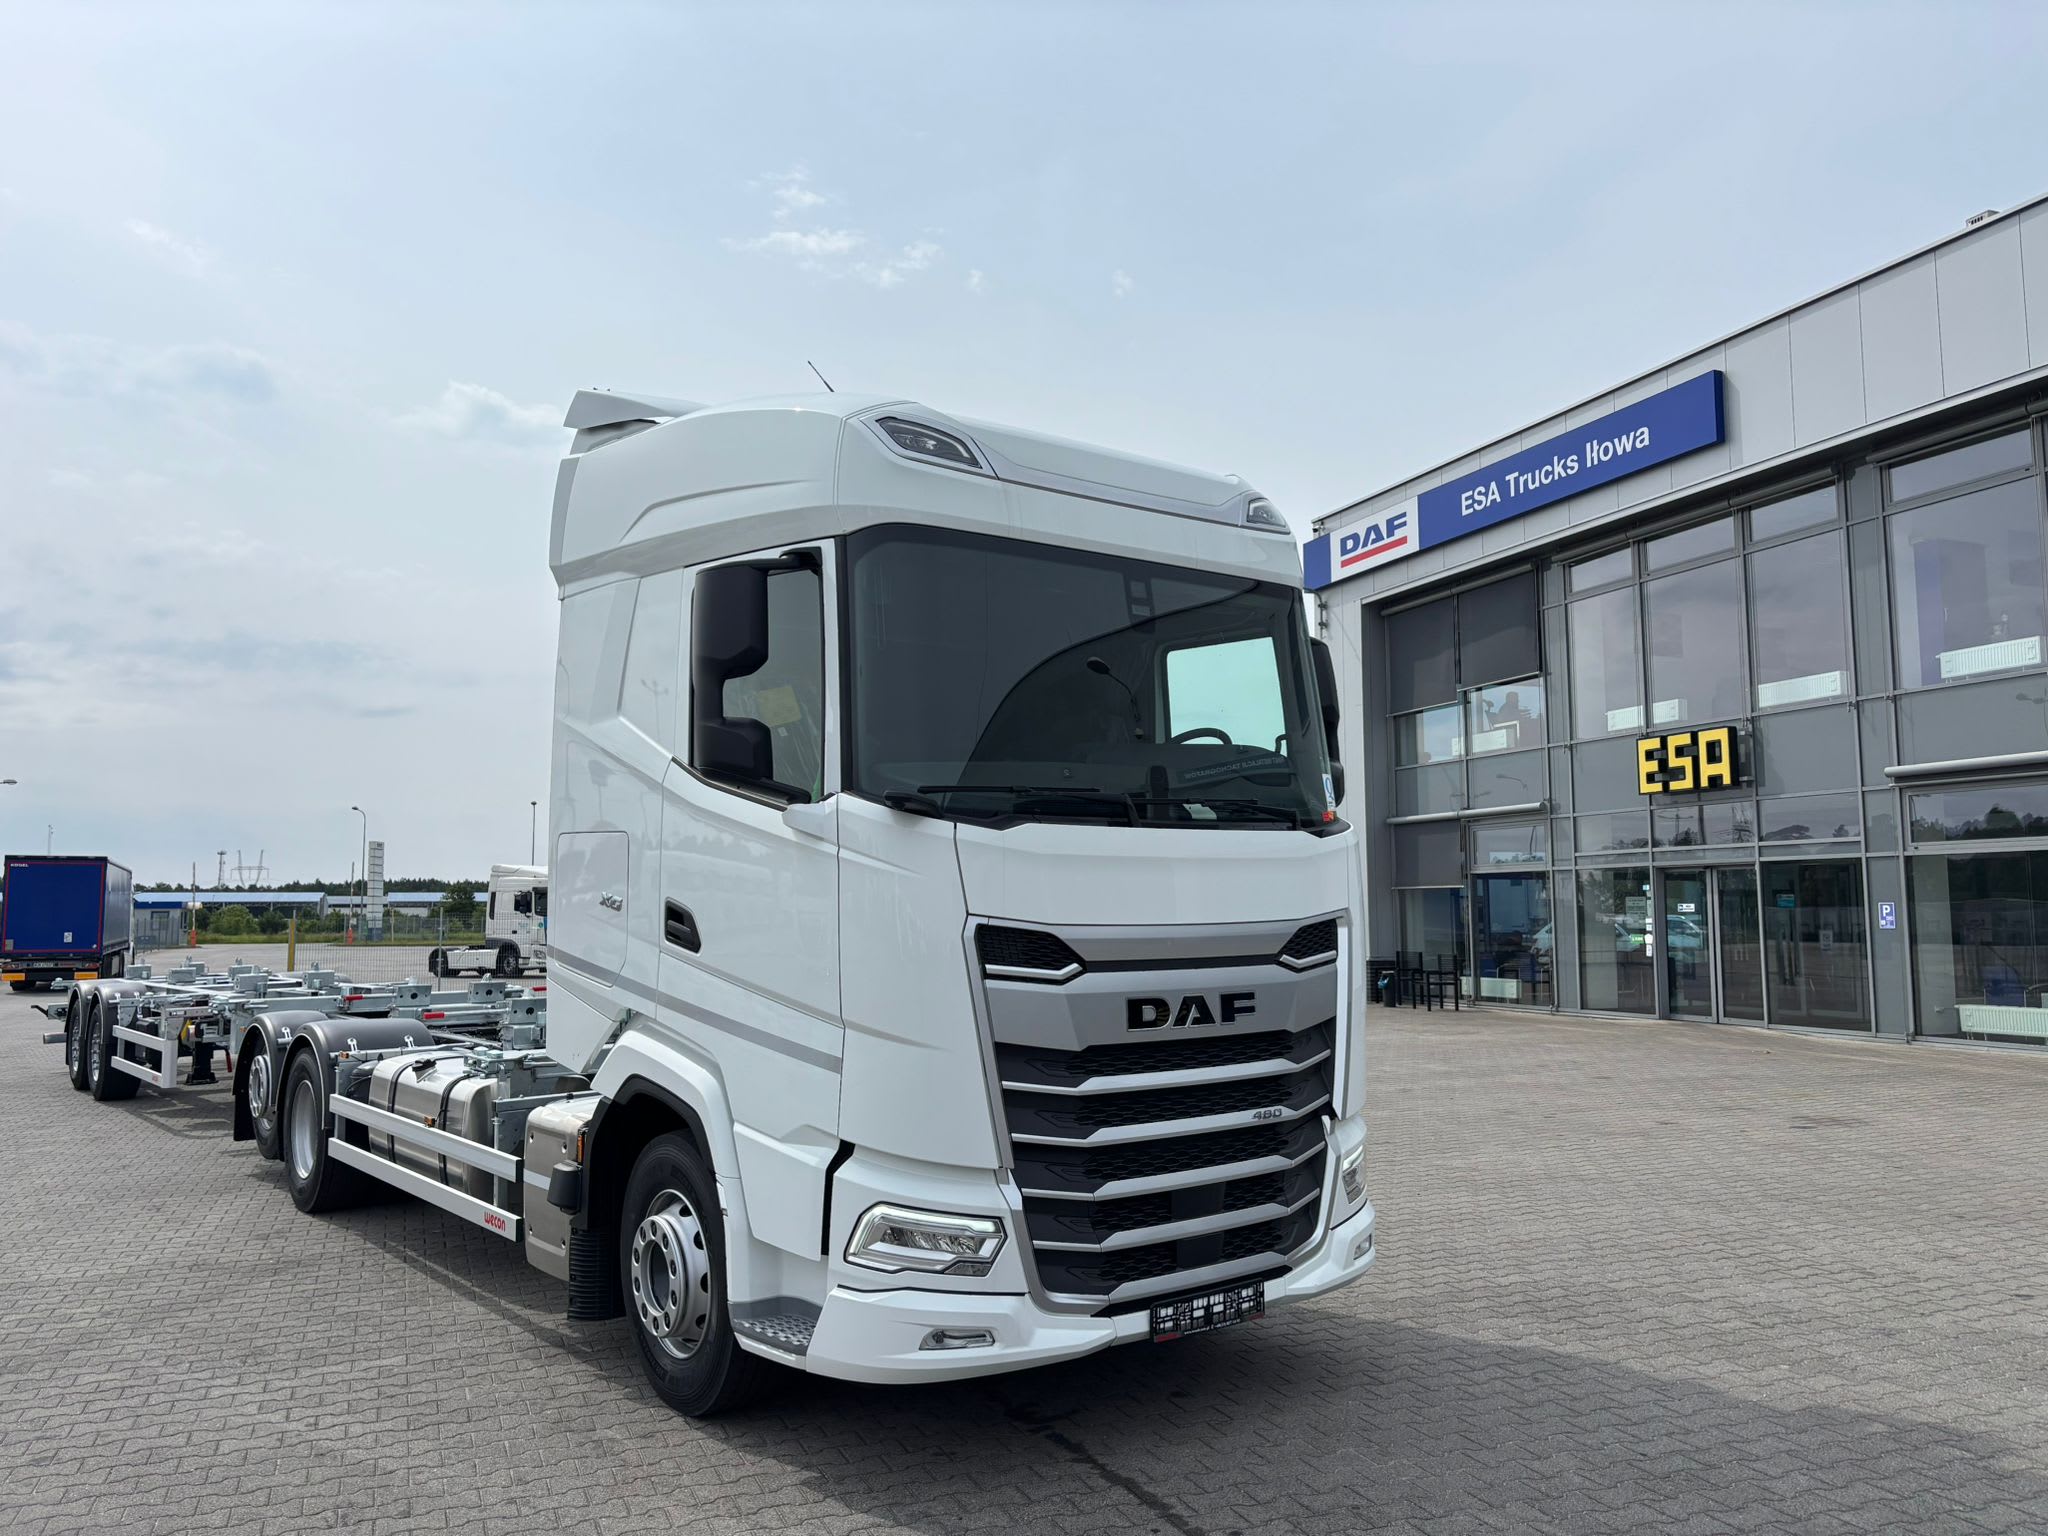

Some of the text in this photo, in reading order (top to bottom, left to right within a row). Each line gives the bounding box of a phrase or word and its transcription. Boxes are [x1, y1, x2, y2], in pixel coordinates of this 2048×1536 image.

[1461, 427, 1650, 517] ESA Trucks Iłowa
[1340, 511, 1408, 556] DAF
[1637, 728, 1733, 794] ESA
[1126, 991, 1257, 1031] DAF
[1251, 1107, 1283, 1121] 480
